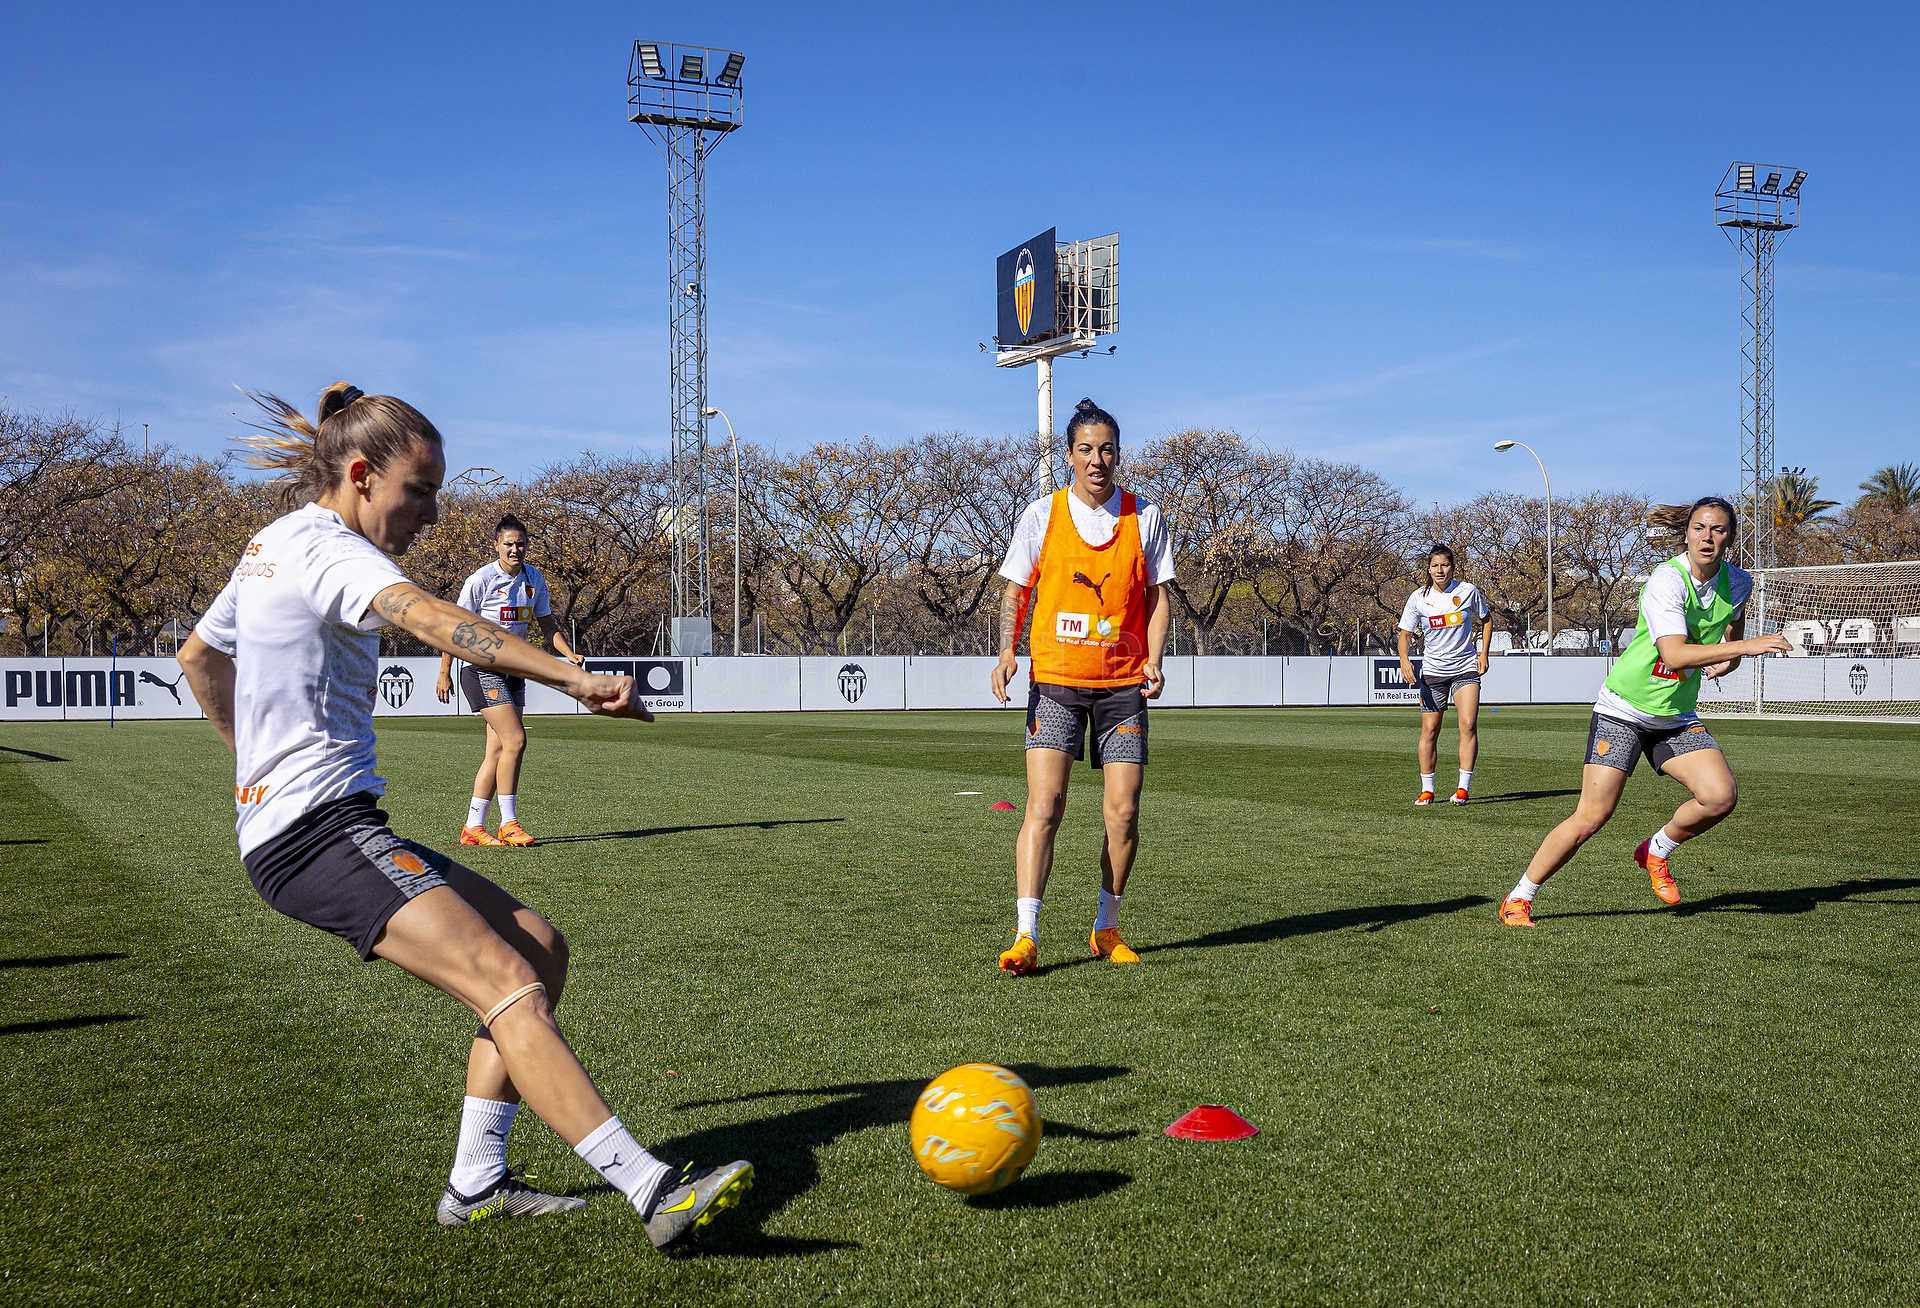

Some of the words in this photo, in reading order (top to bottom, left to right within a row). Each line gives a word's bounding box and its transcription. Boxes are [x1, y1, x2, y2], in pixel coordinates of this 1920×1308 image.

[1061, 619, 1082, 632] TM
[1378, 667, 1403, 684] TM
[5, 670, 136, 707] PUMA
[1374, 692, 1386, 700] TM
[1387, 692, 1402, 700] Real
[1403, 692, 1420, 700] Estat
[655, 699, 684, 709] Group
